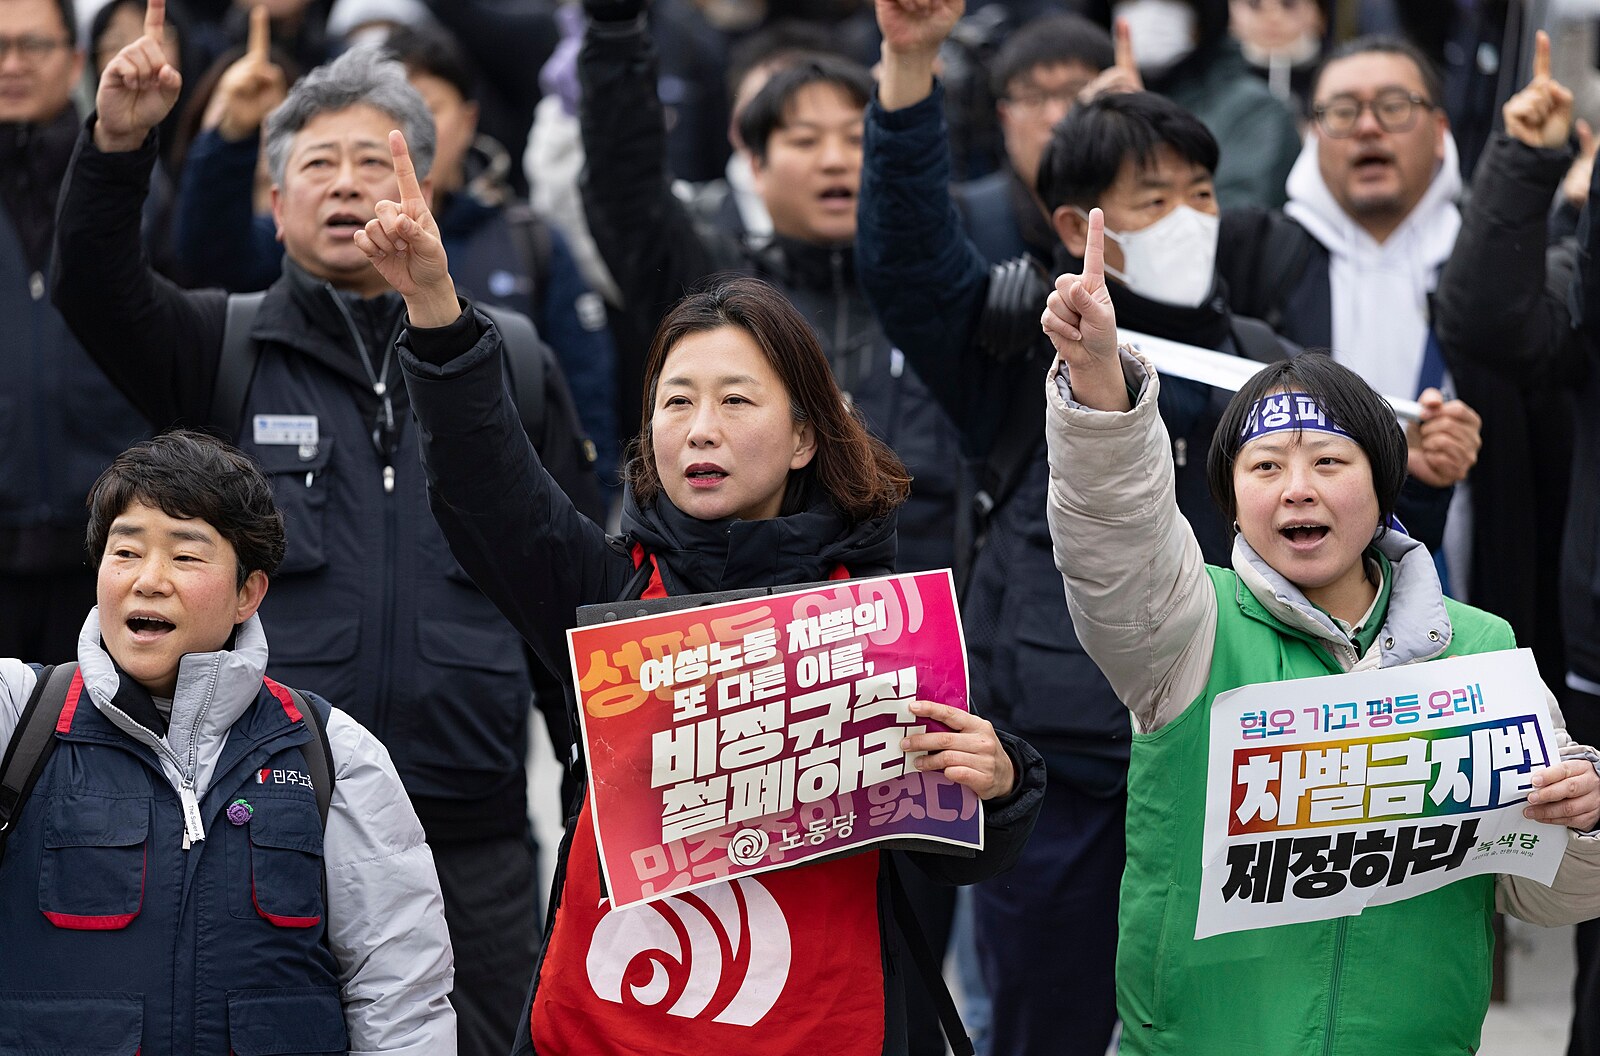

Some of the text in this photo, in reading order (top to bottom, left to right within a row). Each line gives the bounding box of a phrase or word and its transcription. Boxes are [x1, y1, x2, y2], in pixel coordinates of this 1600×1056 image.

[639, 599, 887, 692] 여성노동 차별의
[673, 643, 875, 722] 또 다른 이름,
[651, 666, 917, 789] 비정규직
[1240, 683, 1485, 740] 혐오 가고 평등 오래!
[662, 725, 930, 844] 철폐하라
[1235, 721, 1546, 826] 차별금지법
[190, 815, 198, 832] Super
[779, 811, 857, 851] 노동당
[1221, 818, 1481, 904] 제정하라
[1477, 833, 1540, 852] 녹색당
